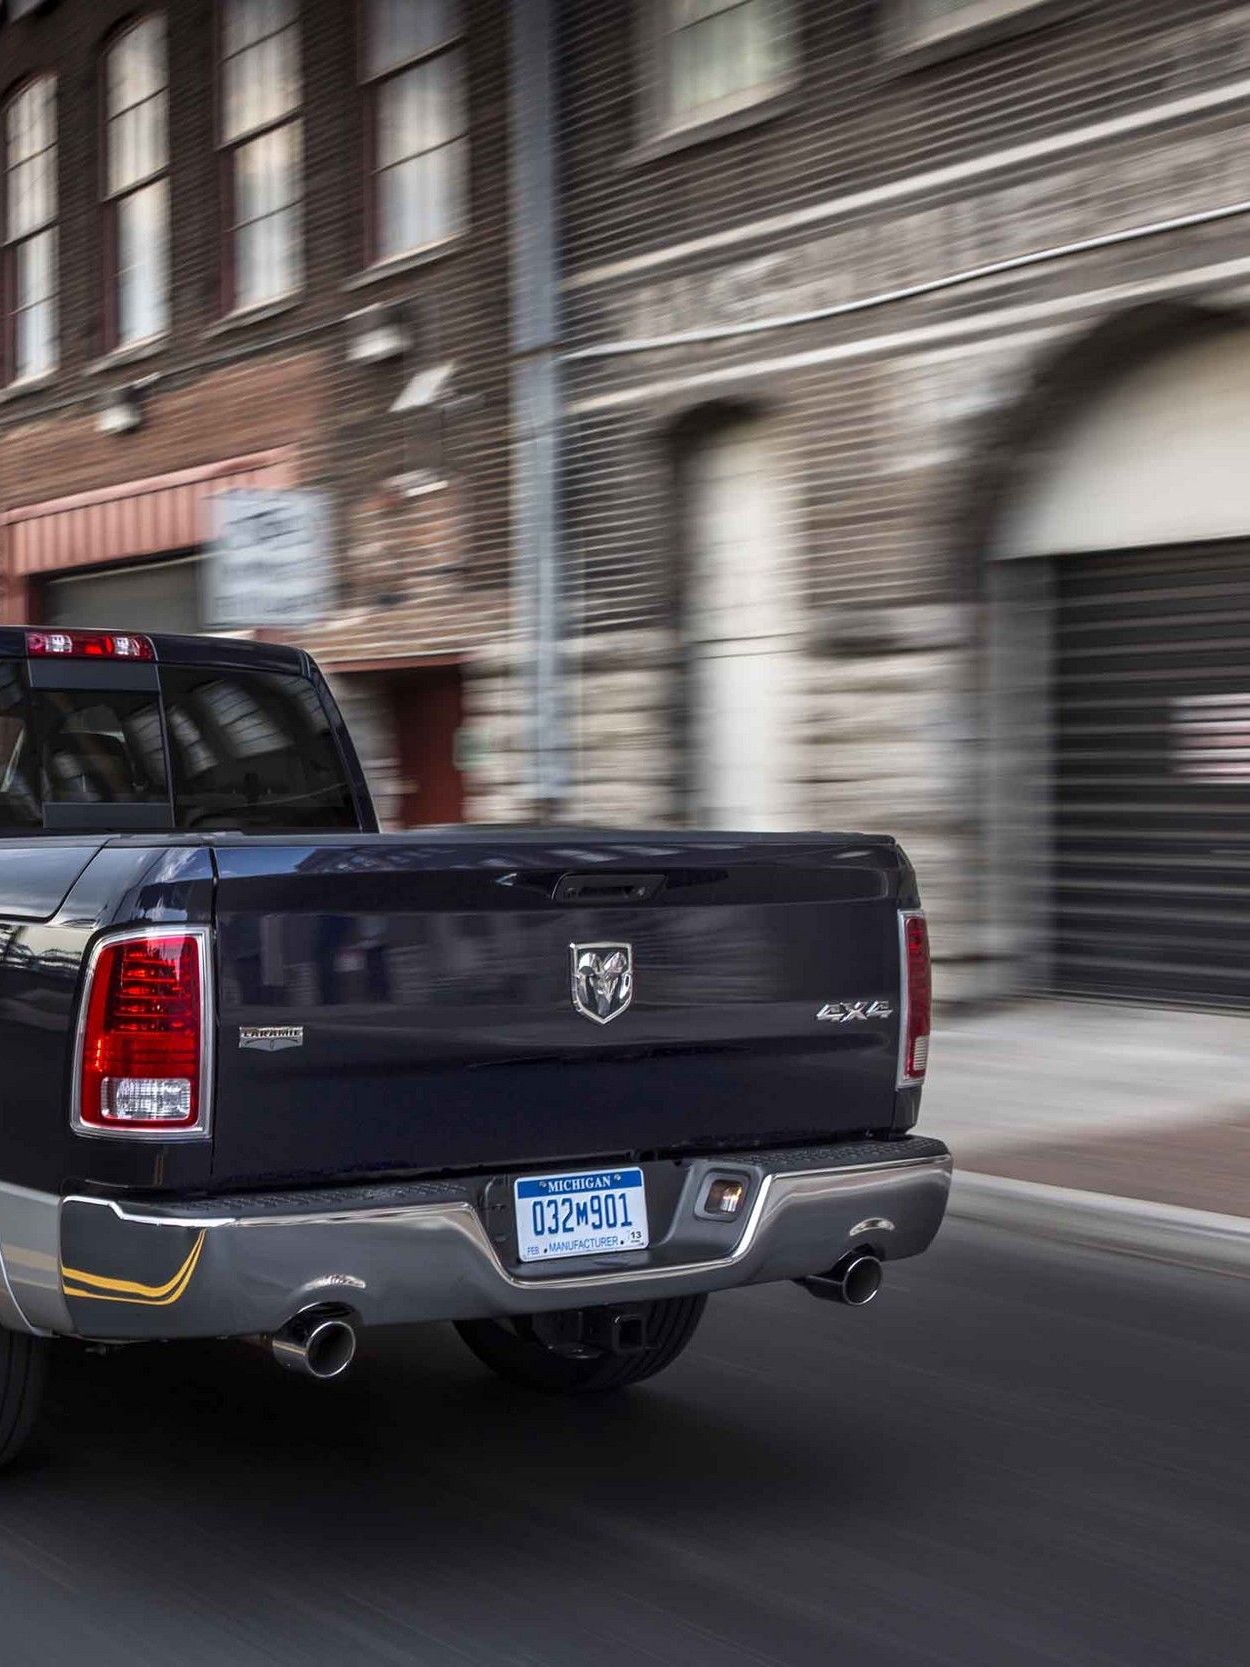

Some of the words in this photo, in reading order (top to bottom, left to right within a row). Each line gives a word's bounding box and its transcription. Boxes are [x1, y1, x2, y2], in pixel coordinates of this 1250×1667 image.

[548, 1175, 611, 1193] MICHIGAN
[532, 1192, 633, 1236] 032M901
[630, 1230, 642, 1240] 13
[527, 1246, 540, 1256] FEB
[548, 1236, 618, 1253] MANUFACTURER
